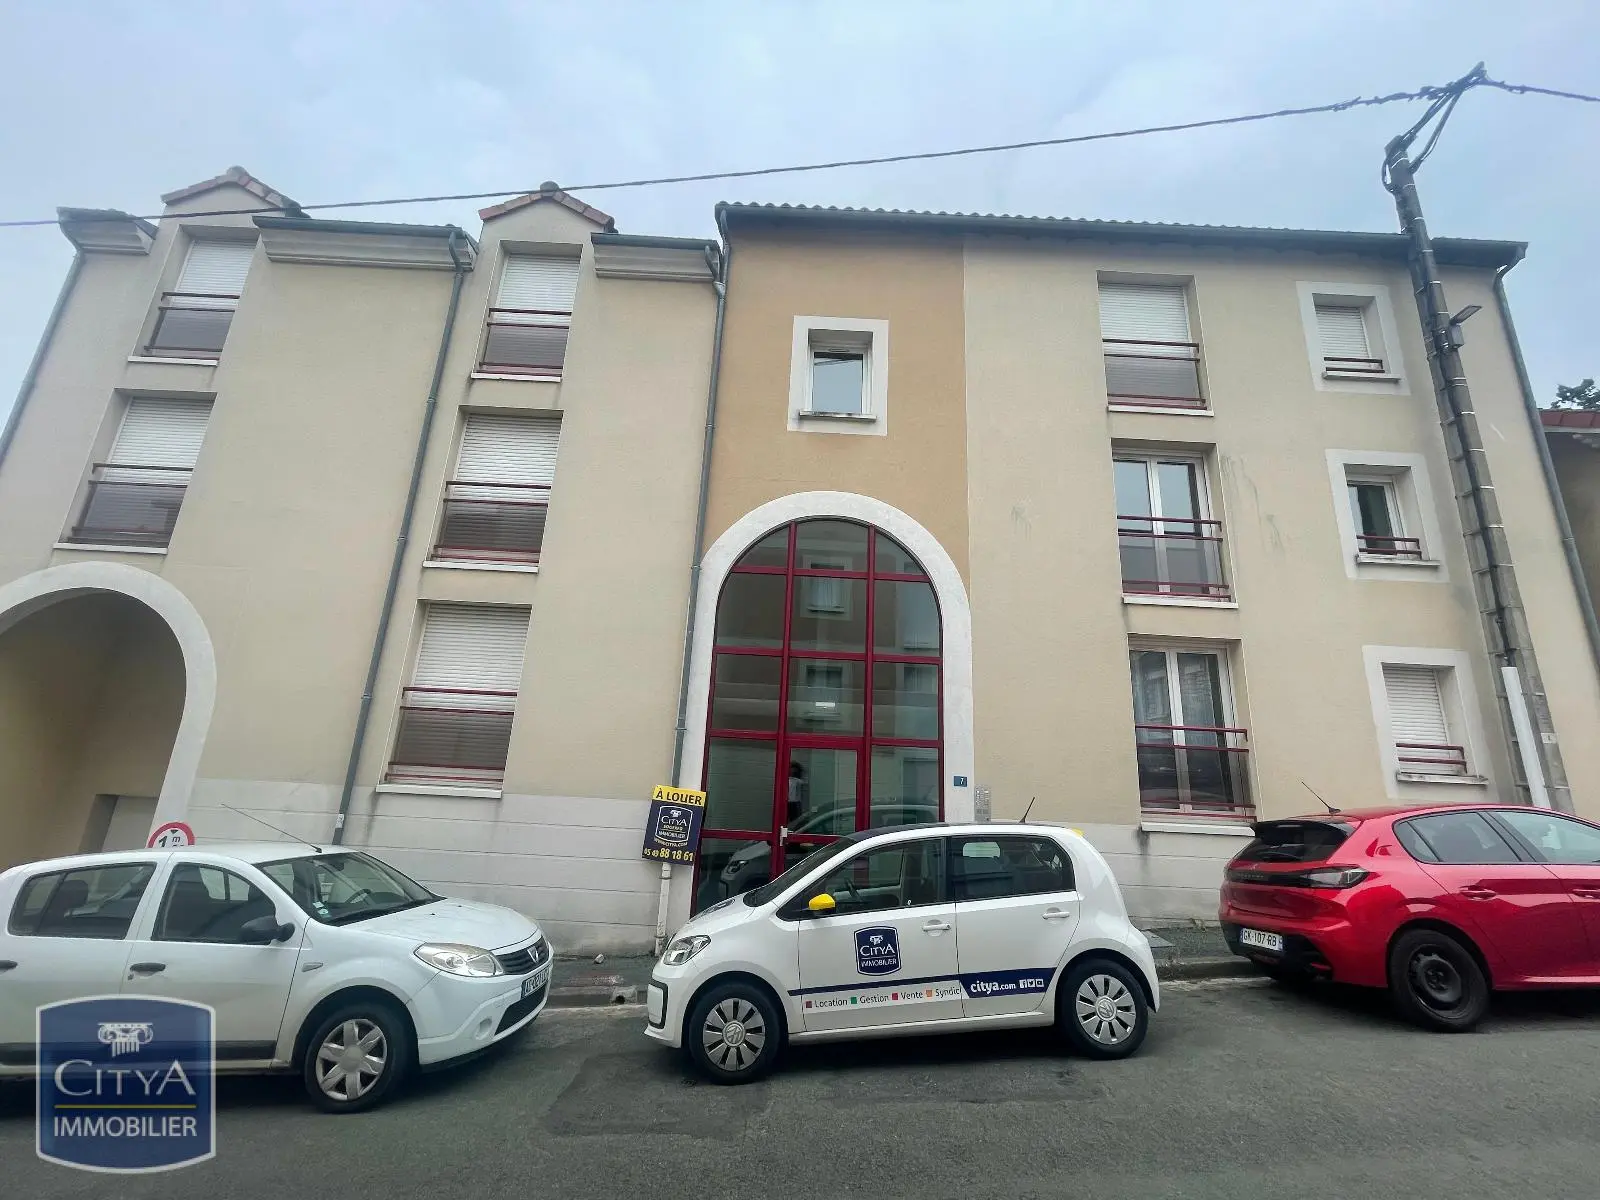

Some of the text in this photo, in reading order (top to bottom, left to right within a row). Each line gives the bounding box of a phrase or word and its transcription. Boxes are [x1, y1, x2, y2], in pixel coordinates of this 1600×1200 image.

[667, 792, 702, 805] LOUER
[659, 847, 670, 858] 88
[861, 958, 897, 967] IMMOBILIER
[815, 998, 848, 1008] Location
[859, 994, 889, 1004] Gestion
[900, 991, 923, 1000] Vente
